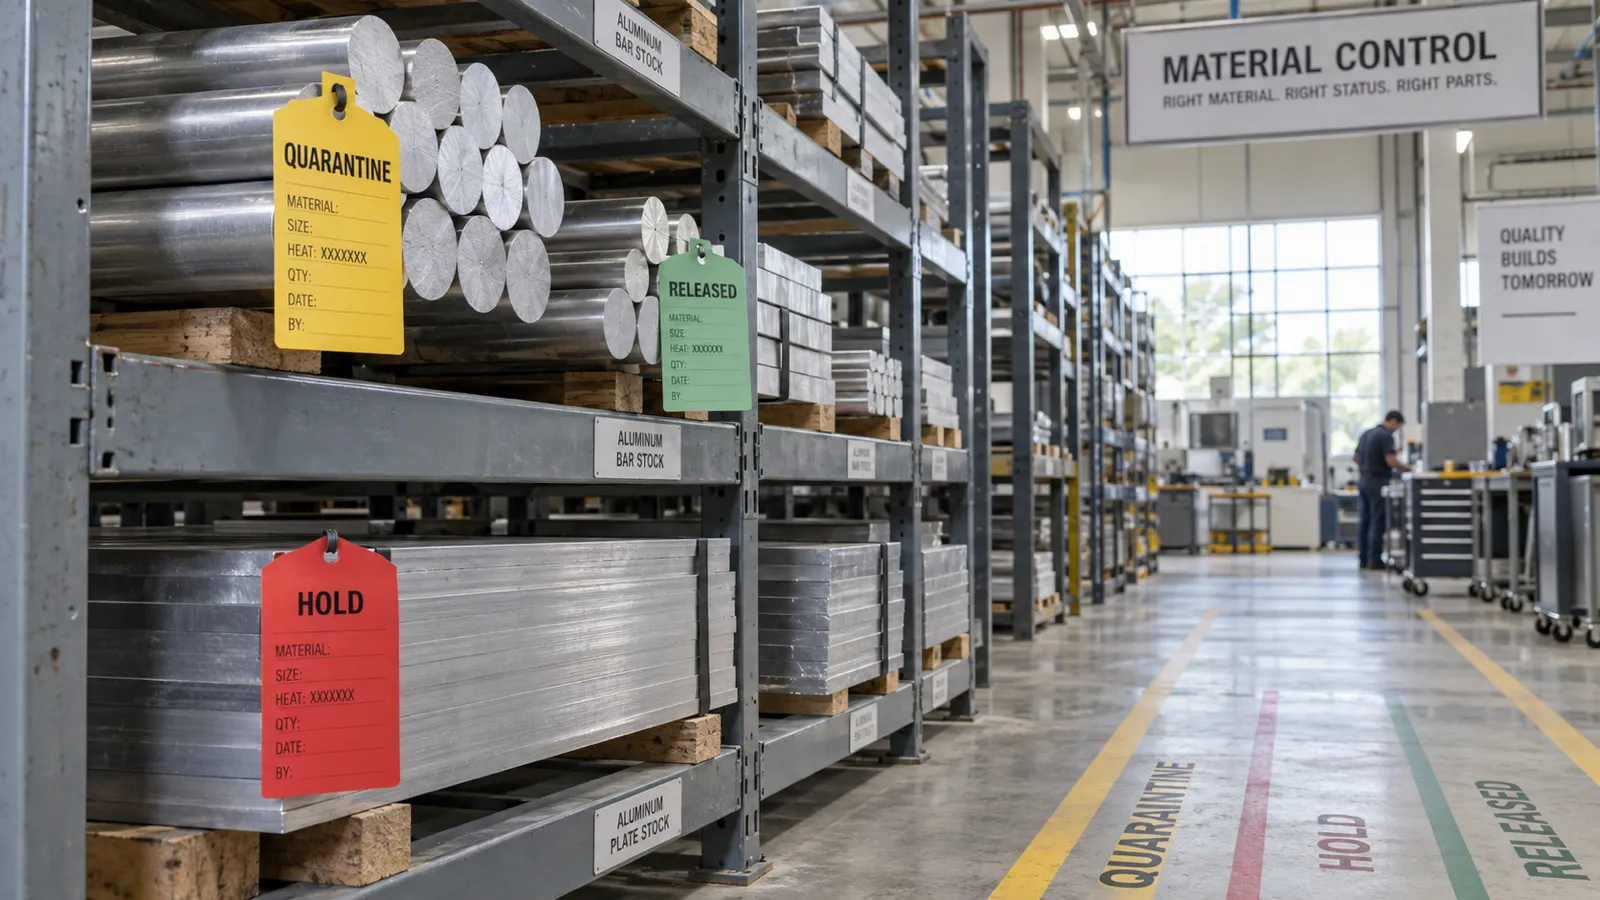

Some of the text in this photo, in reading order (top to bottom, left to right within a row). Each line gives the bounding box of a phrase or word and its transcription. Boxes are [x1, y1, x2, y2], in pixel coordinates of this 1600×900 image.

[617, 12, 662, 55] ALUMINUM
[615, 32, 663, 75] BAR STOCK
[1163, 30, 1497, 84] MATERIAL CONTROL
[1162, 72, 1498, 109] RIGHT MATERIAL. RIGHT STATUS. RIGHT PARTS.
[284, 142, 391, 182] QUARANTINE
[287, 194, 339, 214] MATERIAL:
[287, 218, 313, 234] SIZE:
[1500, 225, 1565, 245] QUALITY
[287, 243, 367, 264] HEAT: XXXXXXX
[1501, 249, 1557, 268] BUILDS
[287, 268, 312, 284] QTY:
[1501, 271, 1594, 291] TOMORROW
[669, 281, 737, 299] RELEASED
[288, 292, 317, 308] DATE:
[288, 318, 305, 331] BY:
[669, 314, 704, 323] MATERIAL:
[670, 328, 687, 338] SIZE:
[670, 344, 689, 353] HEAT:
[670, 360, 686, 369] QTY:
[671, 376, 690, 385] DATE:
[671, 392, 683, 401] BY:
[618, 430, 663, 448] ALUMINUM
[616, 452, 664, 469] BAR STOCK
[298, 590, 364, 616] HOLD
[275, 644, 330, 658] MATERIAL:
[275, 668, 302, 682] SIZE:
[276, 688, 355, 706] HEAT: XXXXXXX
[276, 717, 300, 731] QTY:
[276, 741, 306, 755] DATE:
[276, 767, 292, 780] BY:
[617, 796, 663, 830] ALUMINUM
[610, 814, 670, 855] PLATE STOCK
[1474, 780, 1590, 882] RELEASED
[1318, 813, 1374, 874] HOLD
